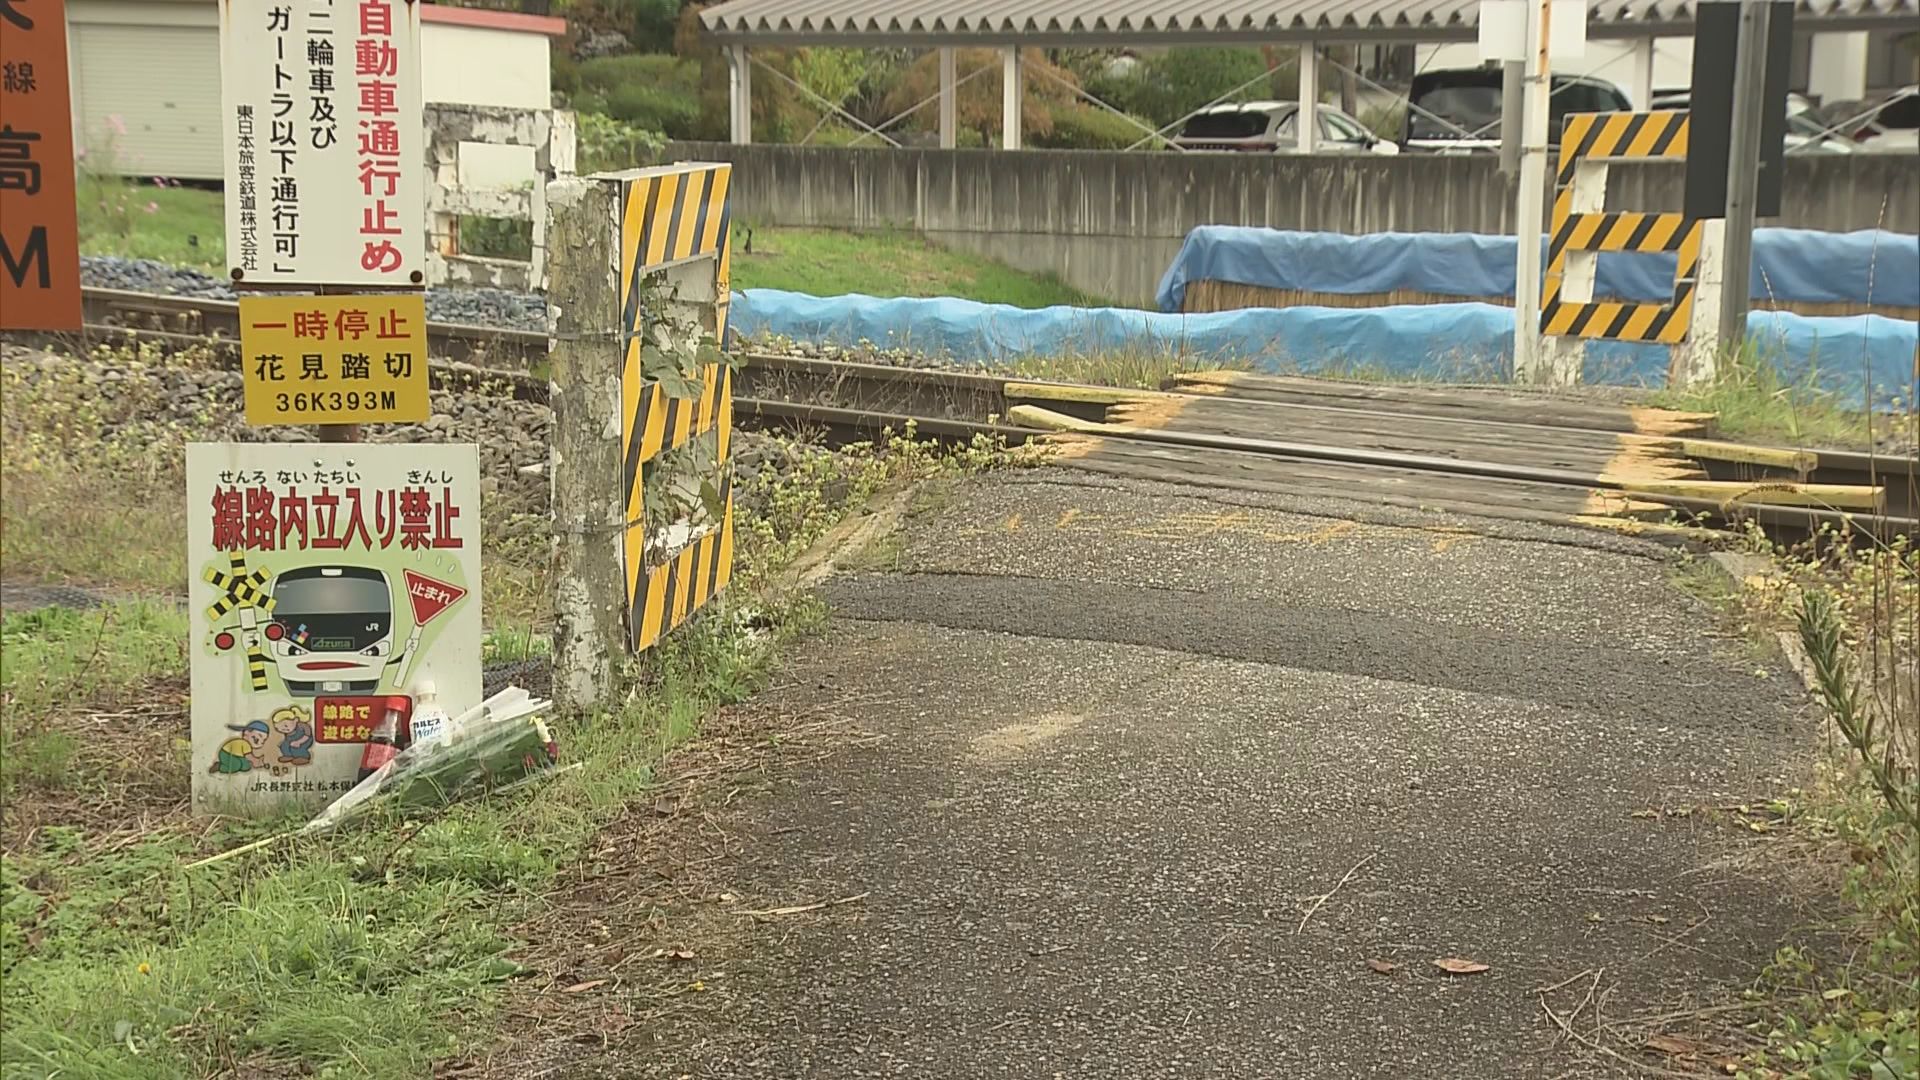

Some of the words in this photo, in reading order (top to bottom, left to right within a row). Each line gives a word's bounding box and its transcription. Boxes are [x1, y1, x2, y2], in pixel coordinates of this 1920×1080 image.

[2, 61, 37, 94] 線
[354, 0, 403, 274] 自動車通行止め
[236, 104, 258, 272] 東日本旅客鉄道株式会社
[252, 308, 412, 341] 一時停止
[254, 352, 413, 382] 花見踏切
[275, 391, 397, 412] 36K393M
[218, 469, 267, 485] せんろ
[276, 469, 308, 484] ない
[313, 469, 361, 485] たちい
[407, 469, 453, 485] きんし
[211, 484, 464, 552] 線路内立入り禁止
[411, 581, 451, 606] 止まれ
[365, 622, 380, 632] JR
[322, 703, 371, 720] 線路で
